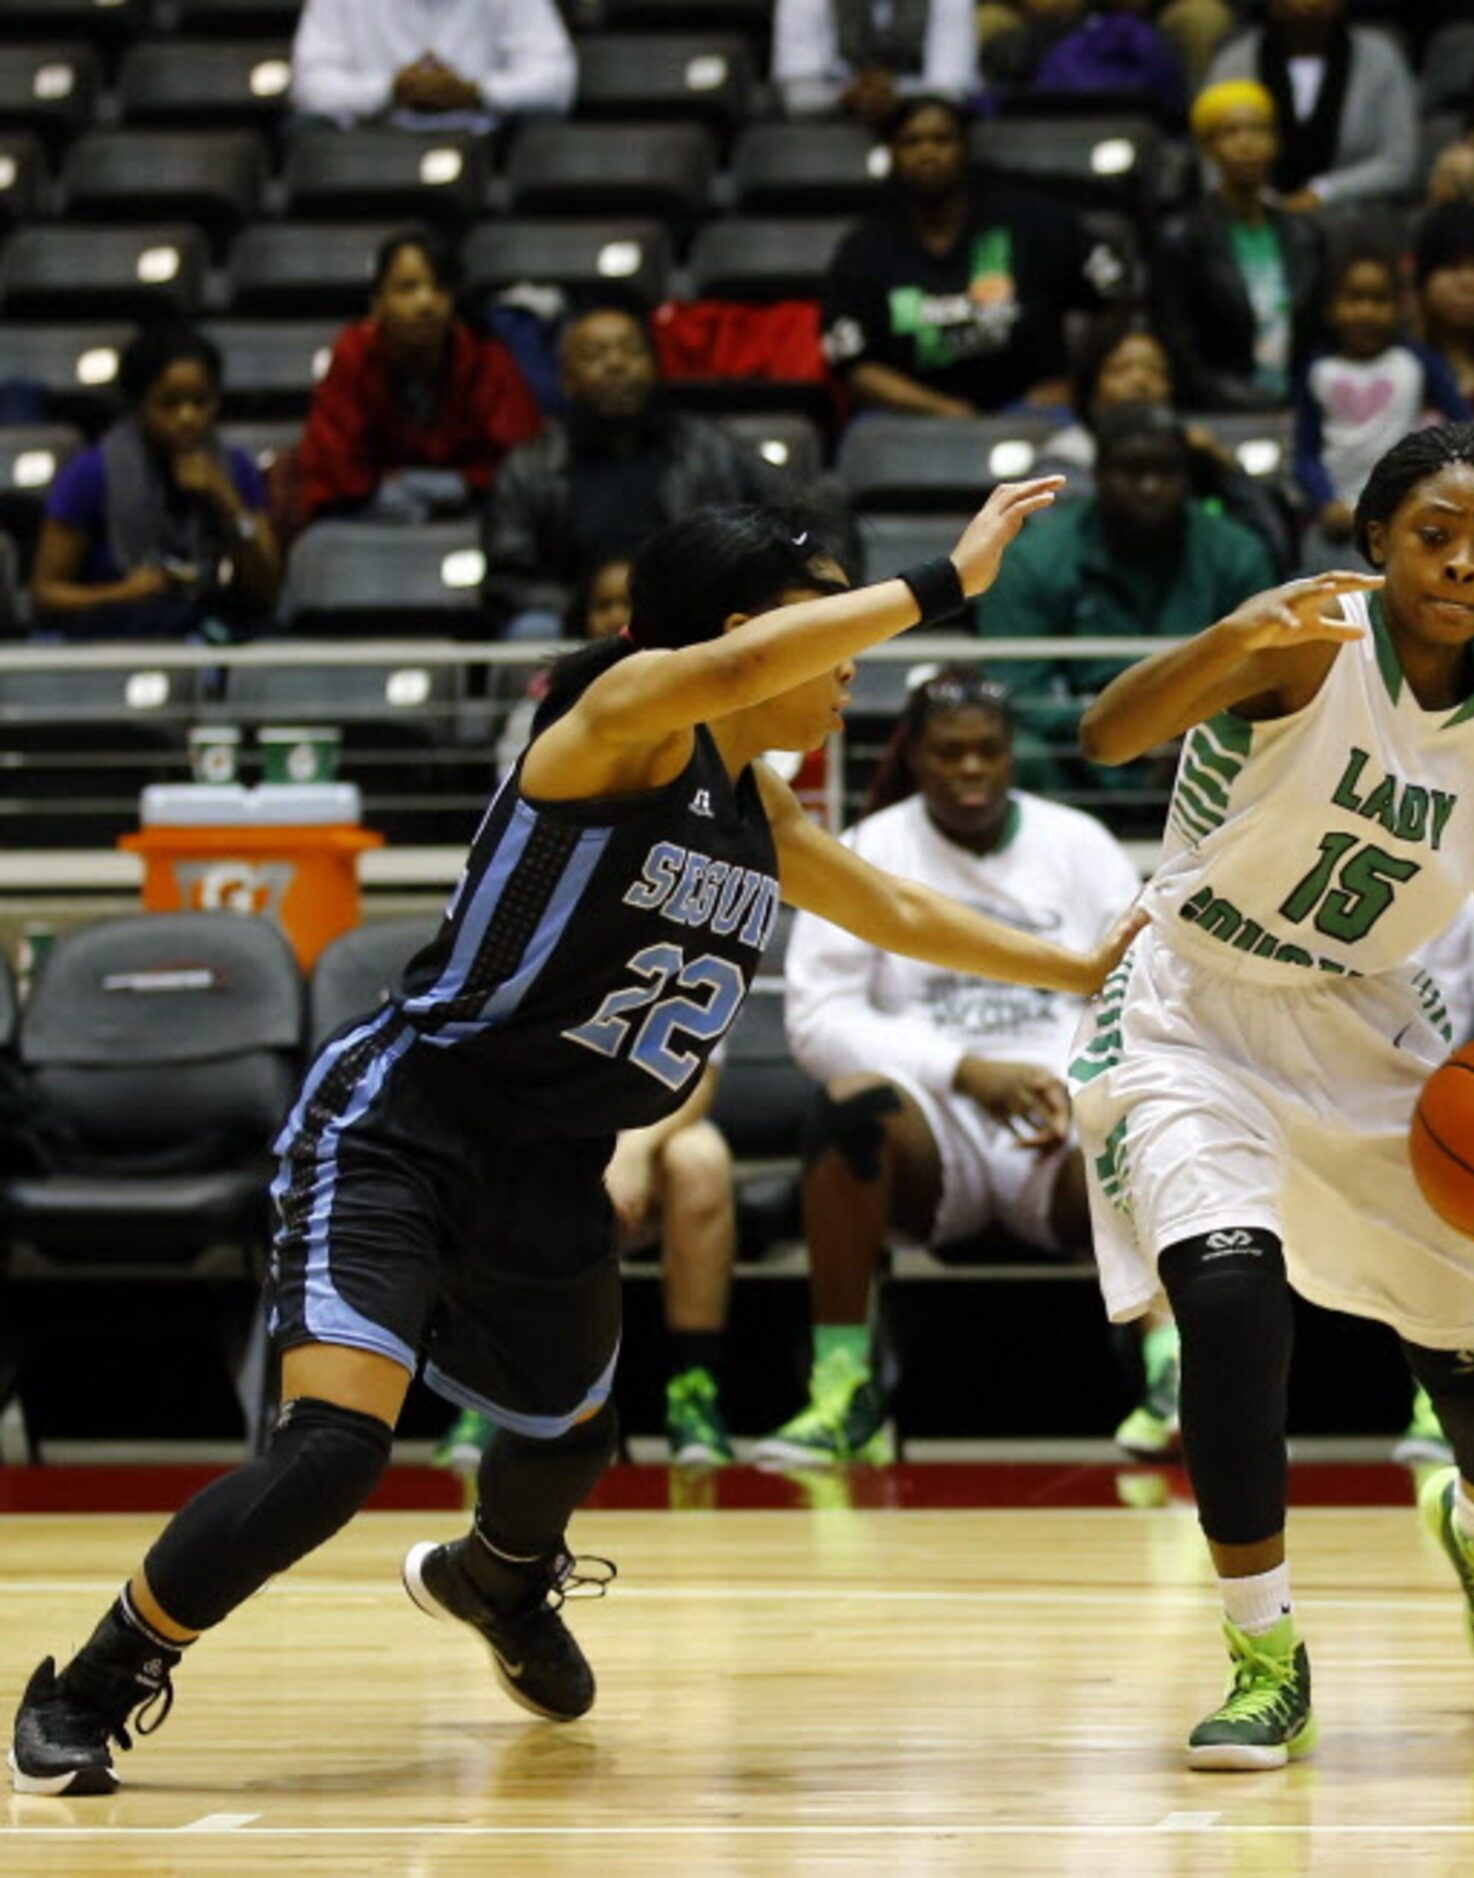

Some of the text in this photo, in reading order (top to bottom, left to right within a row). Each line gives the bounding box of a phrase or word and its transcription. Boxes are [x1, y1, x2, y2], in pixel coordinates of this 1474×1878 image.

[1331, 746, 1458, 850] LADY
[1278, 831, 1422, 945] 15
[560, 941, 747, 1092] 22
